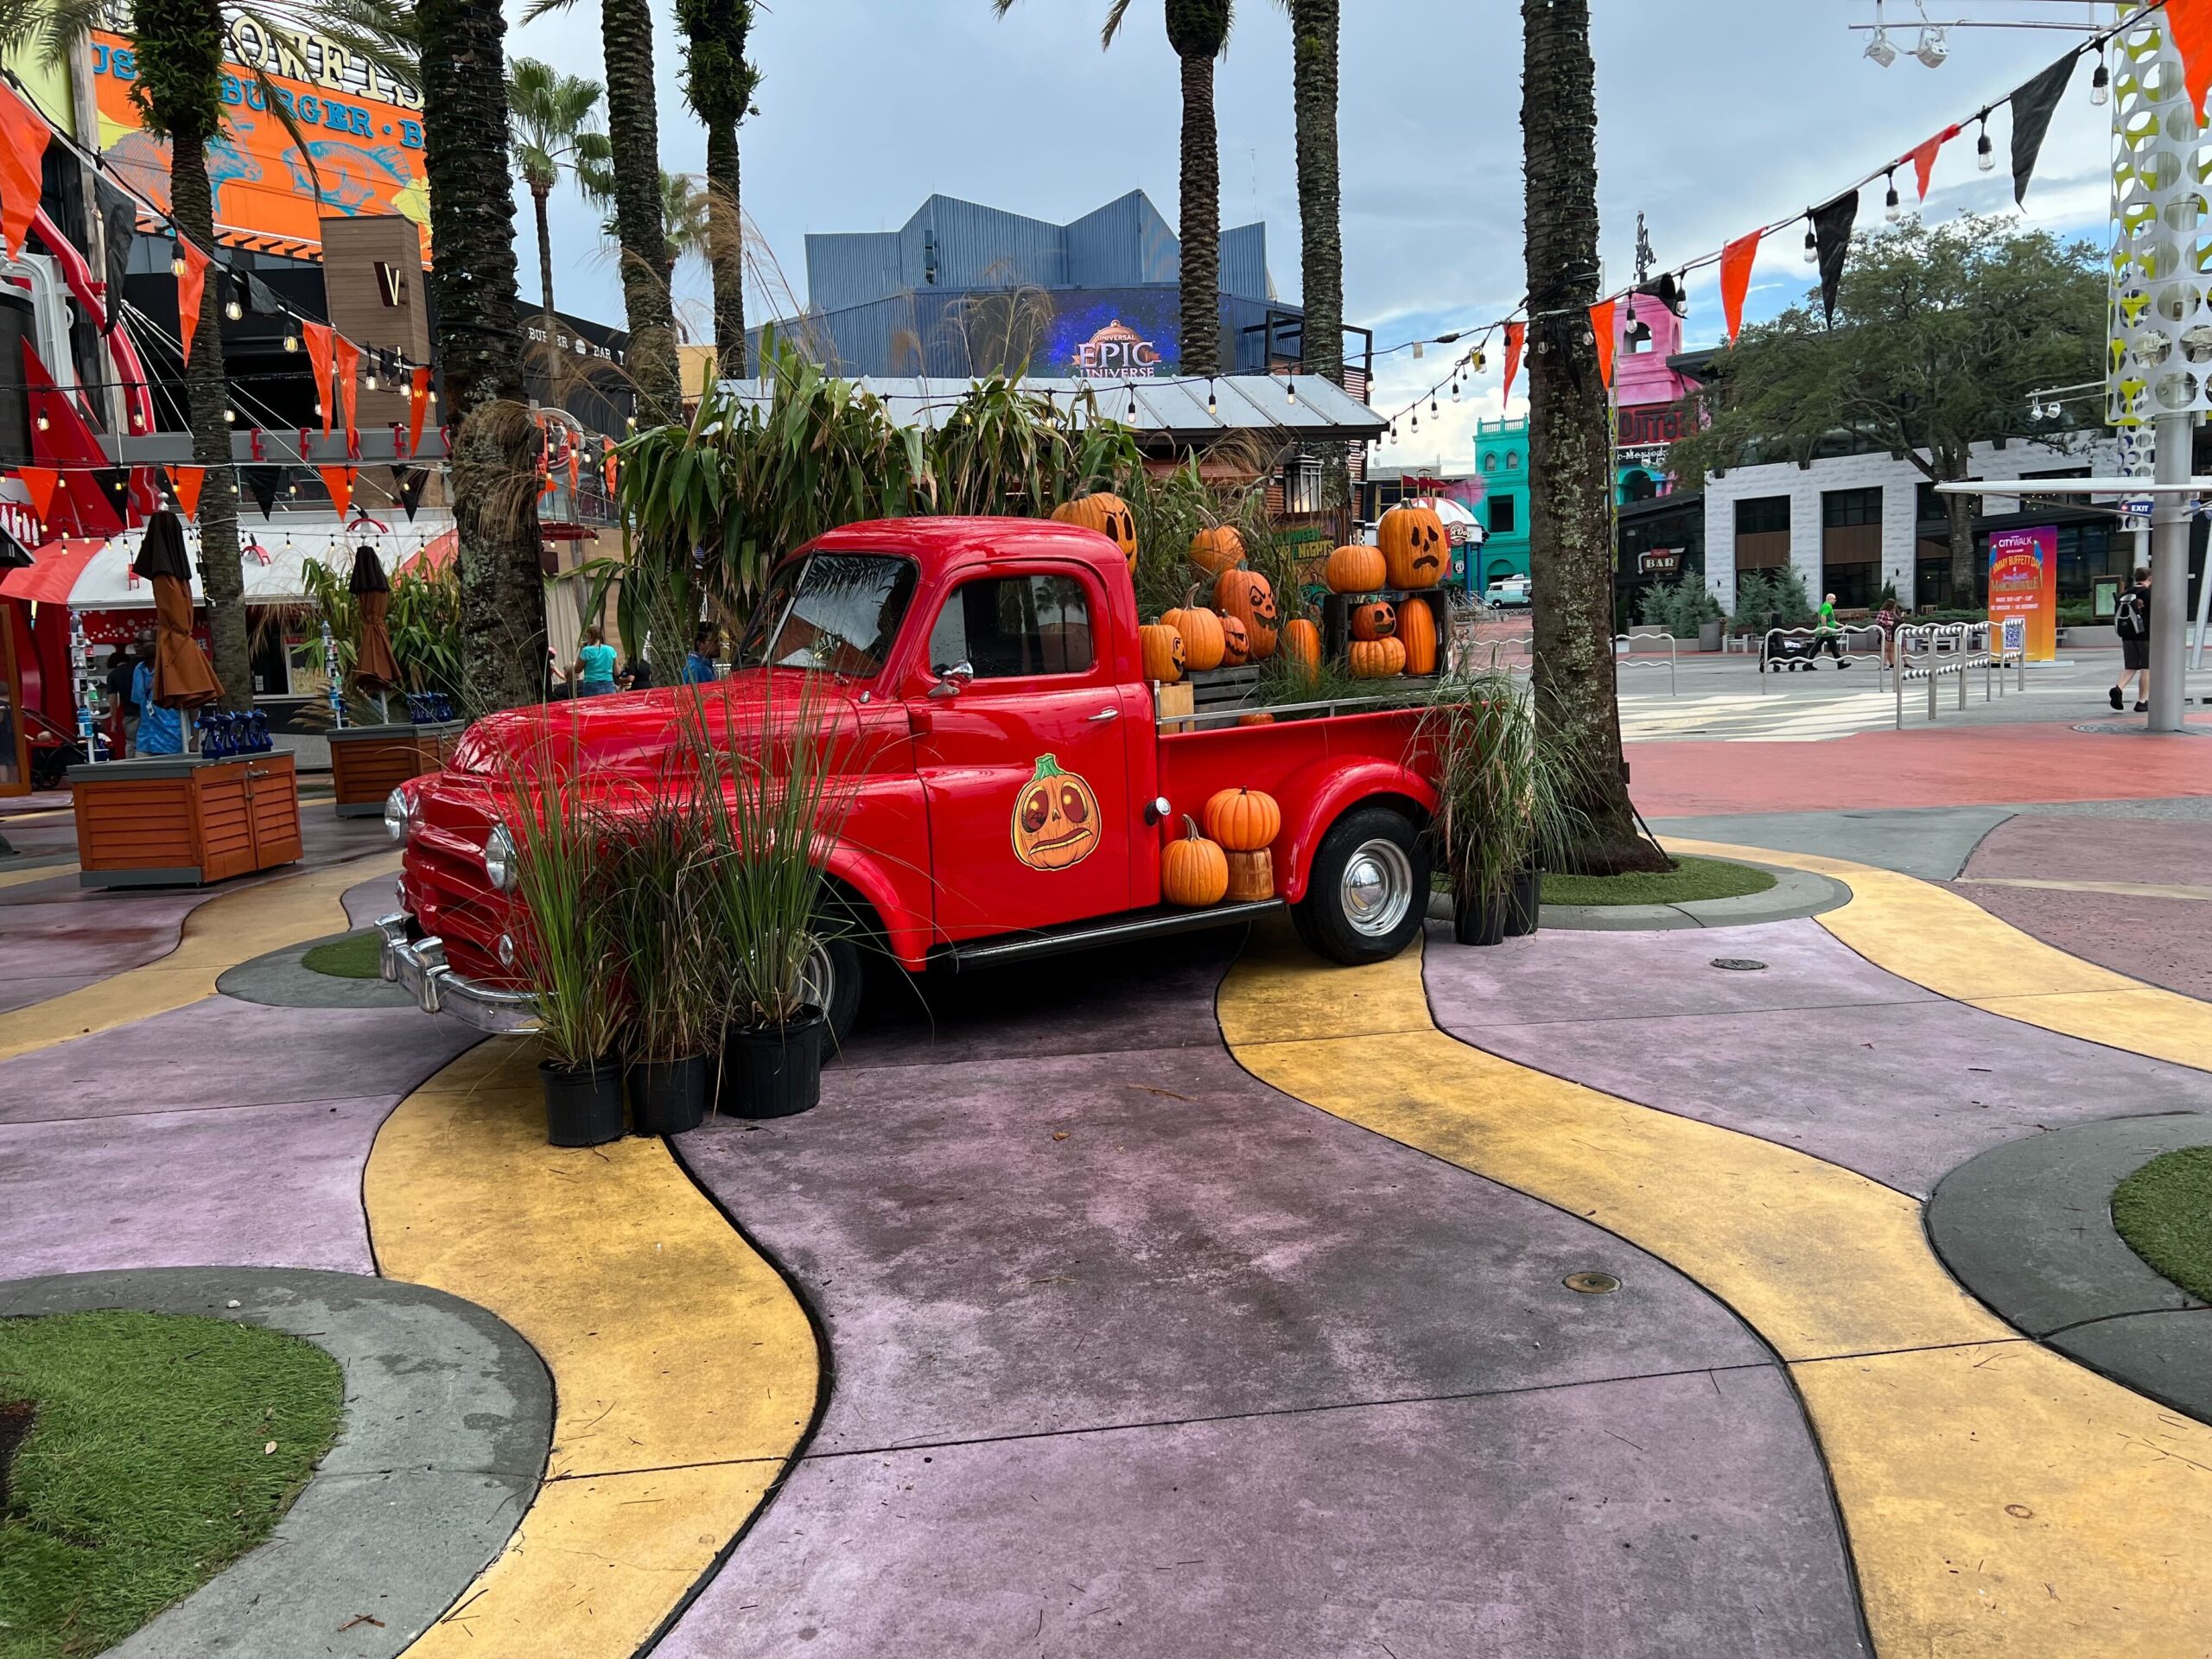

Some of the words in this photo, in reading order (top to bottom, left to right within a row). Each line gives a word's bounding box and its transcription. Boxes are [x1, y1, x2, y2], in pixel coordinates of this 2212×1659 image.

[229, 15, 425, 111] OWFIS
[219, 74, 374, 137] BURGER
[528, 327, 569, 349] BURER
[1077, 341, 1154, 368] EPIC
[1080, 367, 1154, 378] UNIVERSE
[1999, 537, 2032, 548] CITYWALK
[1646, 557, 1675, 569] BAR
[2008, 555, 2031, 567] BUFFETT
